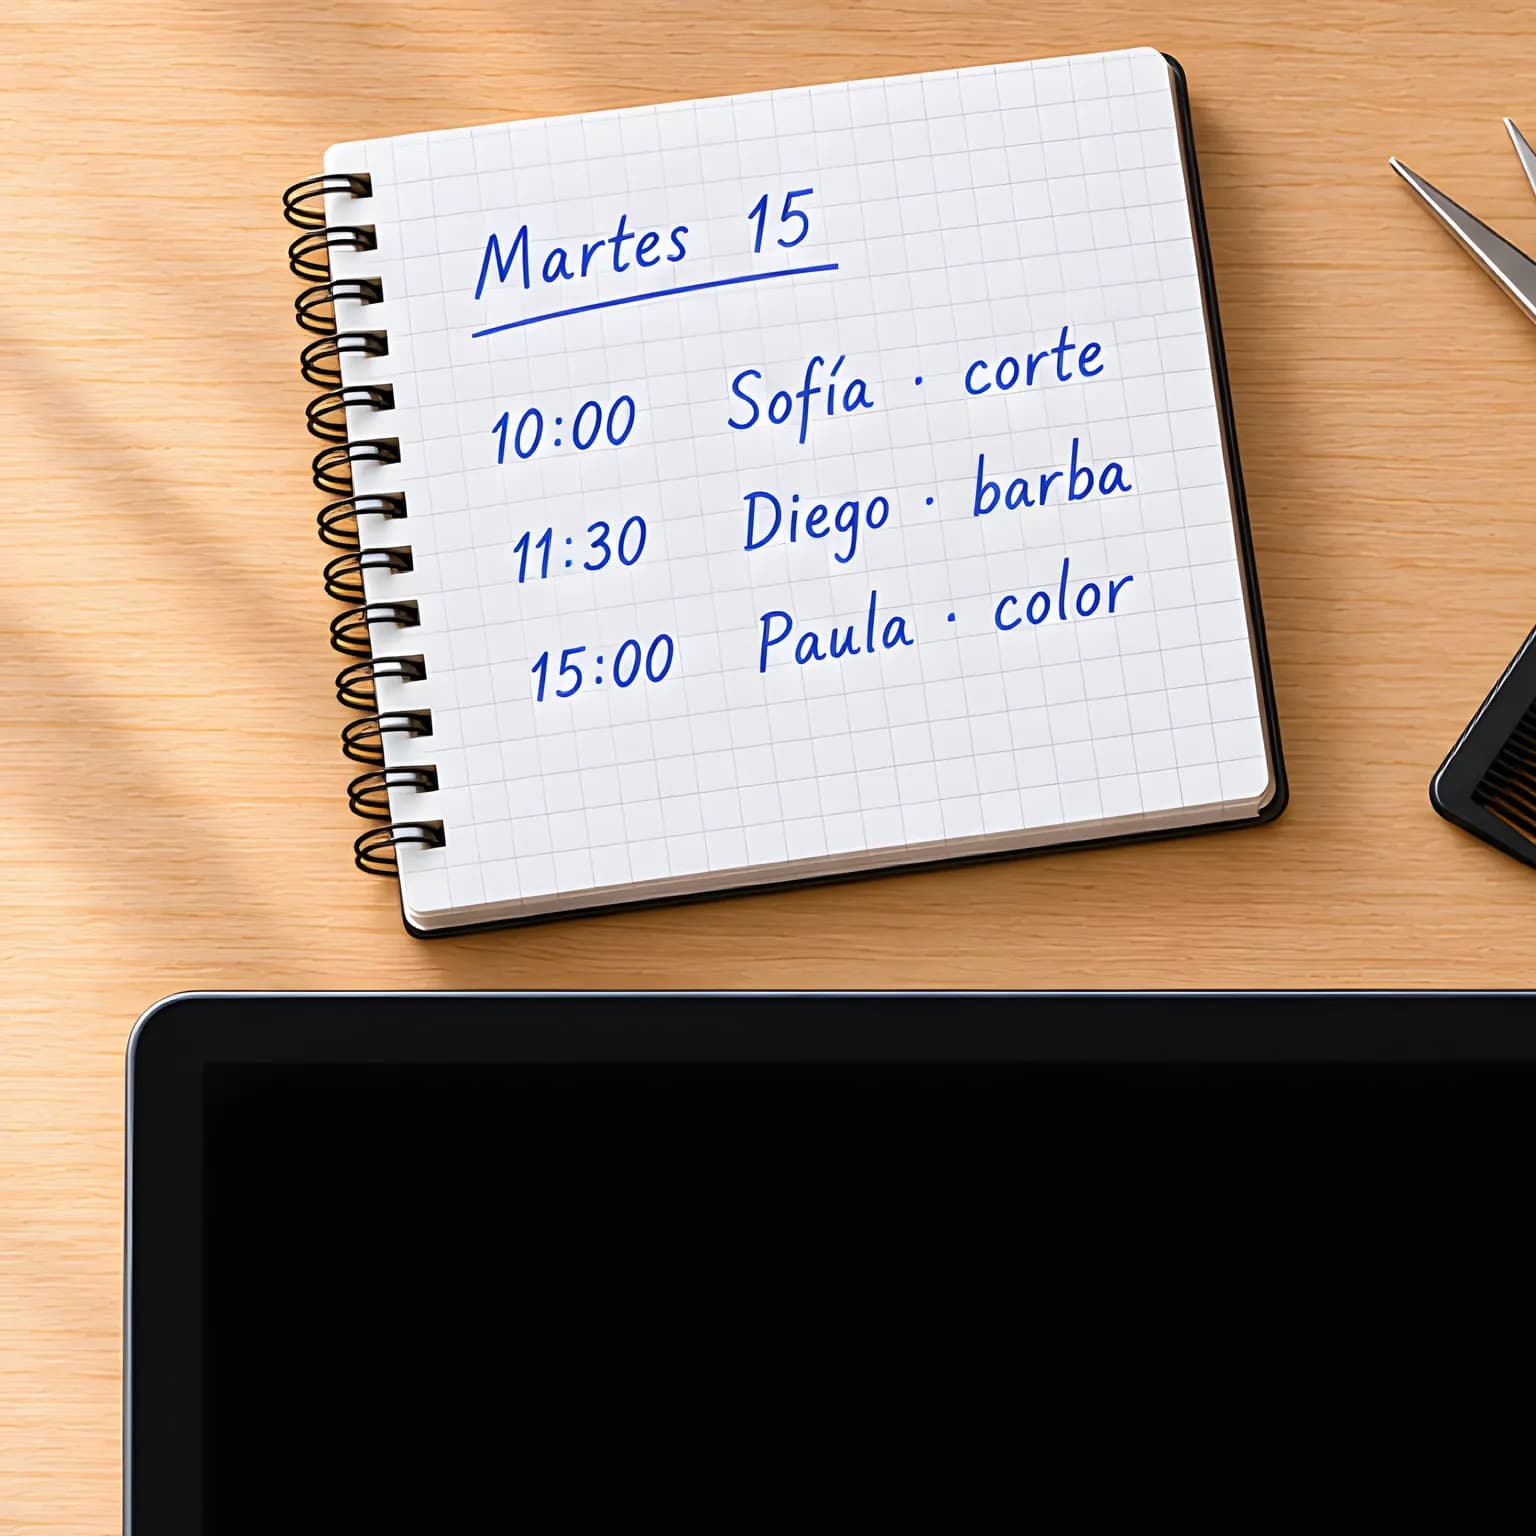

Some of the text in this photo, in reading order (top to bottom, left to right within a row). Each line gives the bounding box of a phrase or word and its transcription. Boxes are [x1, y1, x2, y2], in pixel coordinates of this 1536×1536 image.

[474, 187, 815, 300] Martes 15
[491, 394, 636, 465] 10:00
[727, 353, 875, 445] Sofía
[964, 325, 1105, 396] corte
[513, 514, 647, 584] 11:30
[743, 490, 890, 565] Diego
[972, 436, 1133, 518] barba
[530, 633, 675, 703] 15:00
[759, 589, 915, 674] Paula
[994, 556, 1135, 632] color
